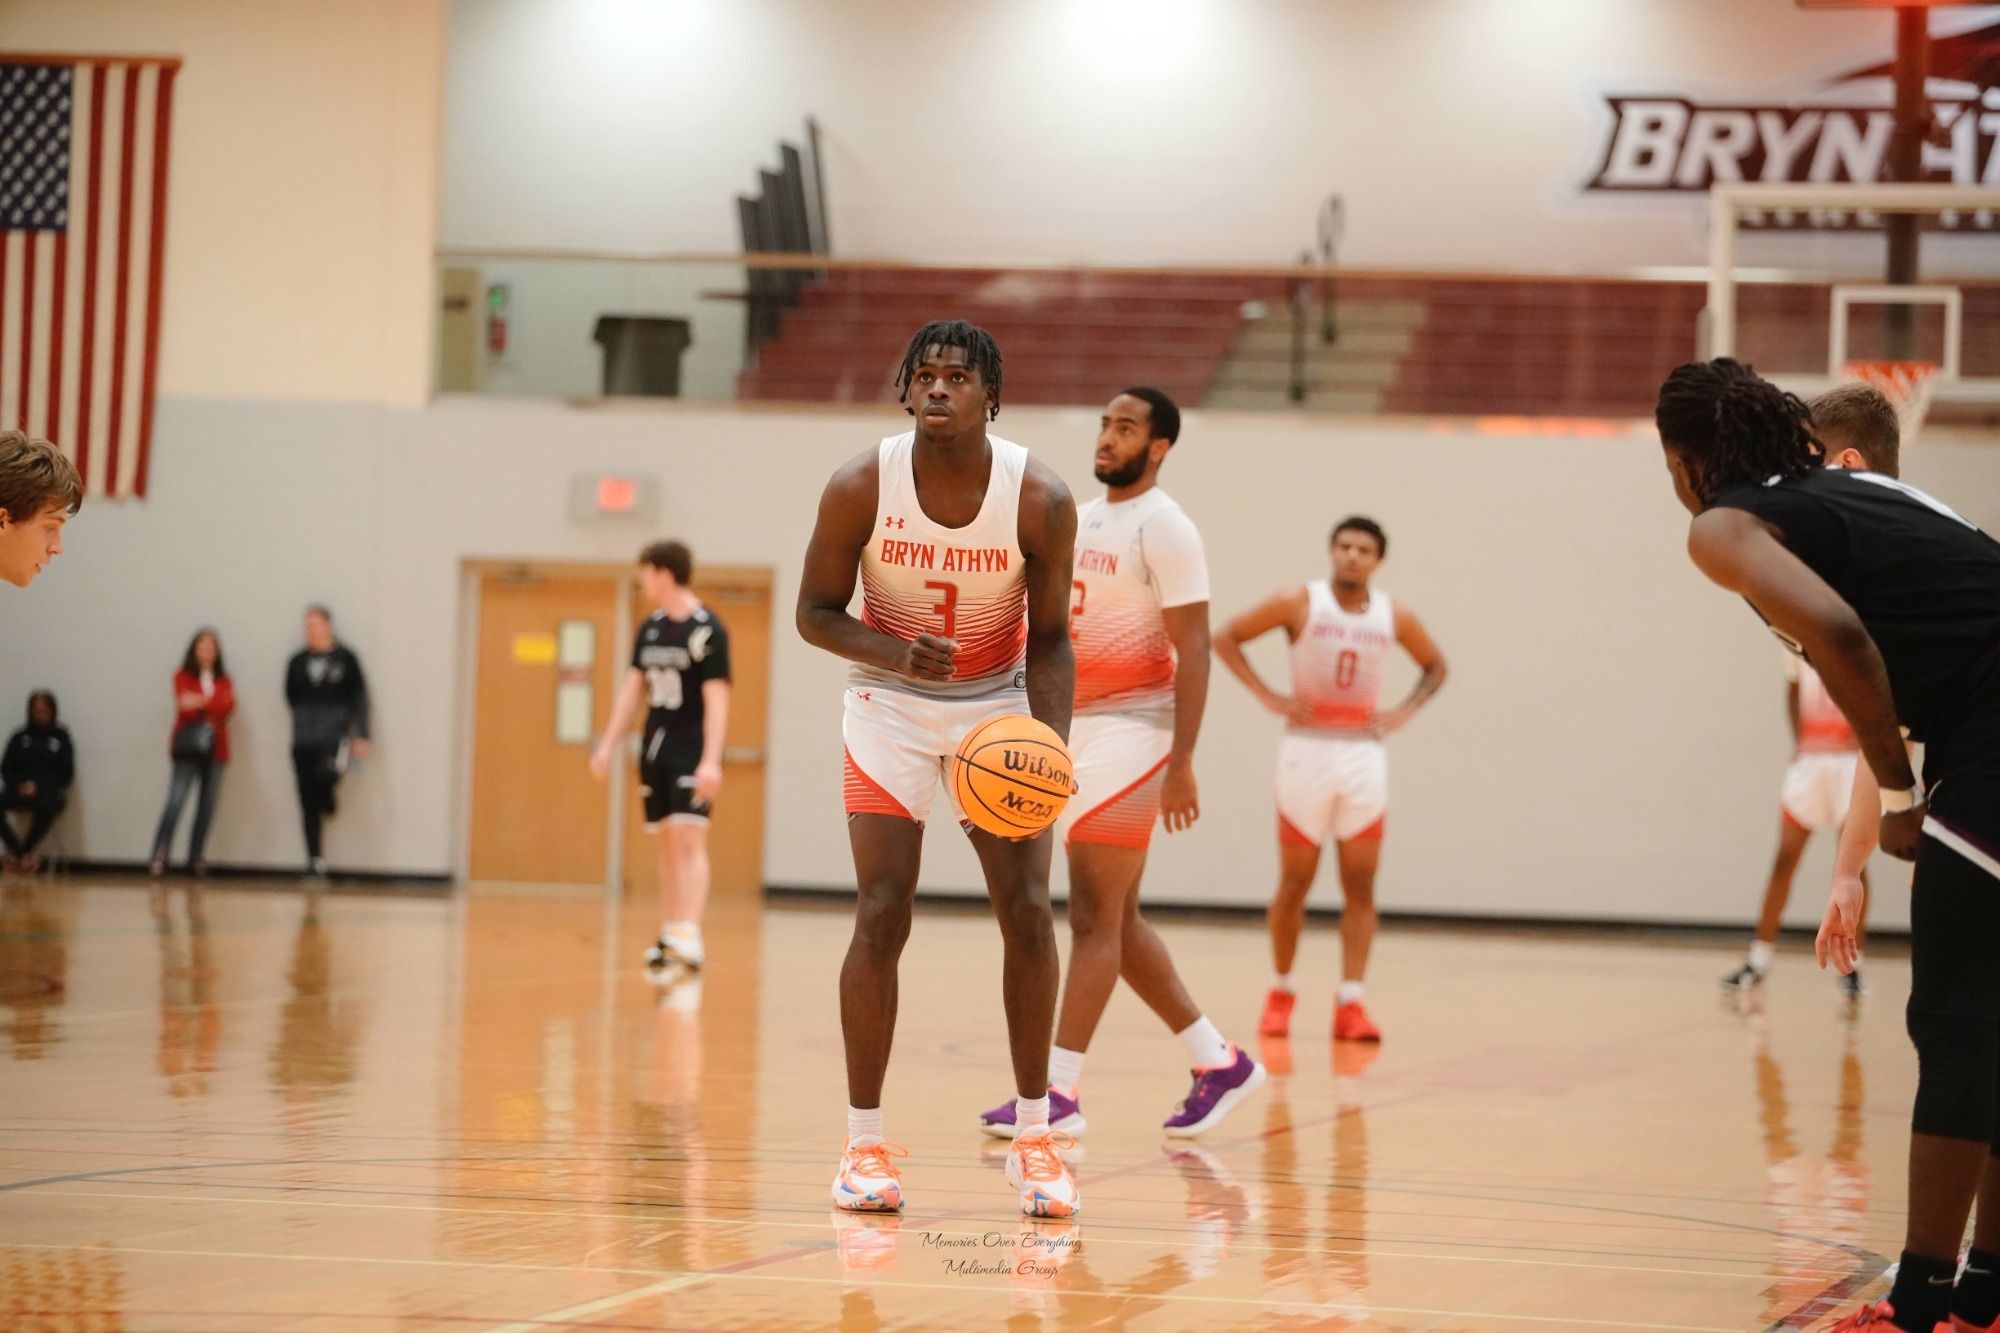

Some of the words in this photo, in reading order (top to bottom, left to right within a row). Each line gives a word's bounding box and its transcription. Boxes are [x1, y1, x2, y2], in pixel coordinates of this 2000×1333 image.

[1601, 98, 1896, 186] BRYN
[880, 539, 935, 570] BRYN
[942, 547, 1008, 572] ATHYN
[1077, 549, 1119, 576] ATHYN
[924, 579, 959, 640] 3
[1336, 649, 1358, 689] 0
[1004, 749, 1070, 788] Wilson
[1000, 790, 1054, 818] NCAA
